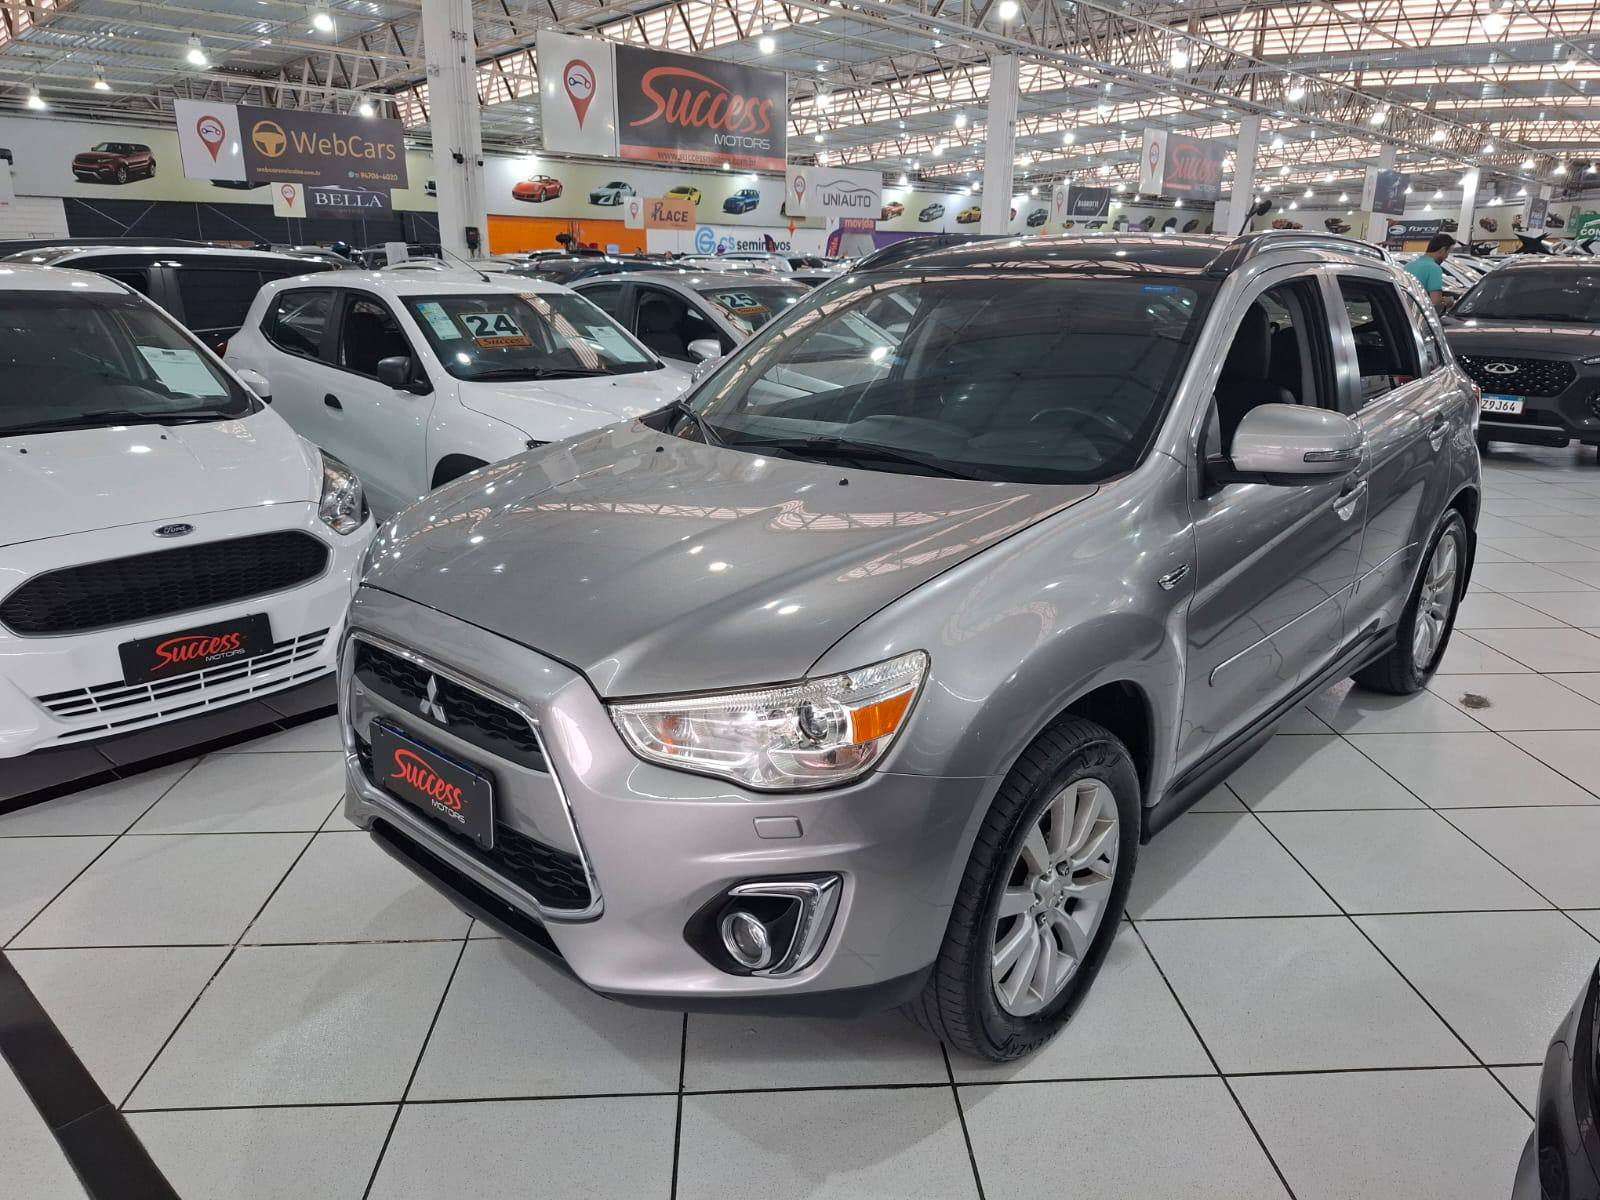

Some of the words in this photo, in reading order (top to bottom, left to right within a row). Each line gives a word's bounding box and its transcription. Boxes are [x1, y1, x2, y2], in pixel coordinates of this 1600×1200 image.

[630, 67, 774, 134] Success
[291, 130, 396, 160] WebCars
[714, 133, 771, 150] MOTORS
[315, 191, 383, 208] BELLA
[823, 192, 871, 208] UNIAUTO
[737, 236, 791, 251] seminvos
[720, 293, 759, 308] 25
[466, 312, 520, 337] 24
[163, 524, 188, 534] Ford
[151, 632, 241, 671] Success
[205, 648, 246, 662] MOTORS
[391, 748, 464, 810] Success
[431, 798, 466, 824] MOTORS
